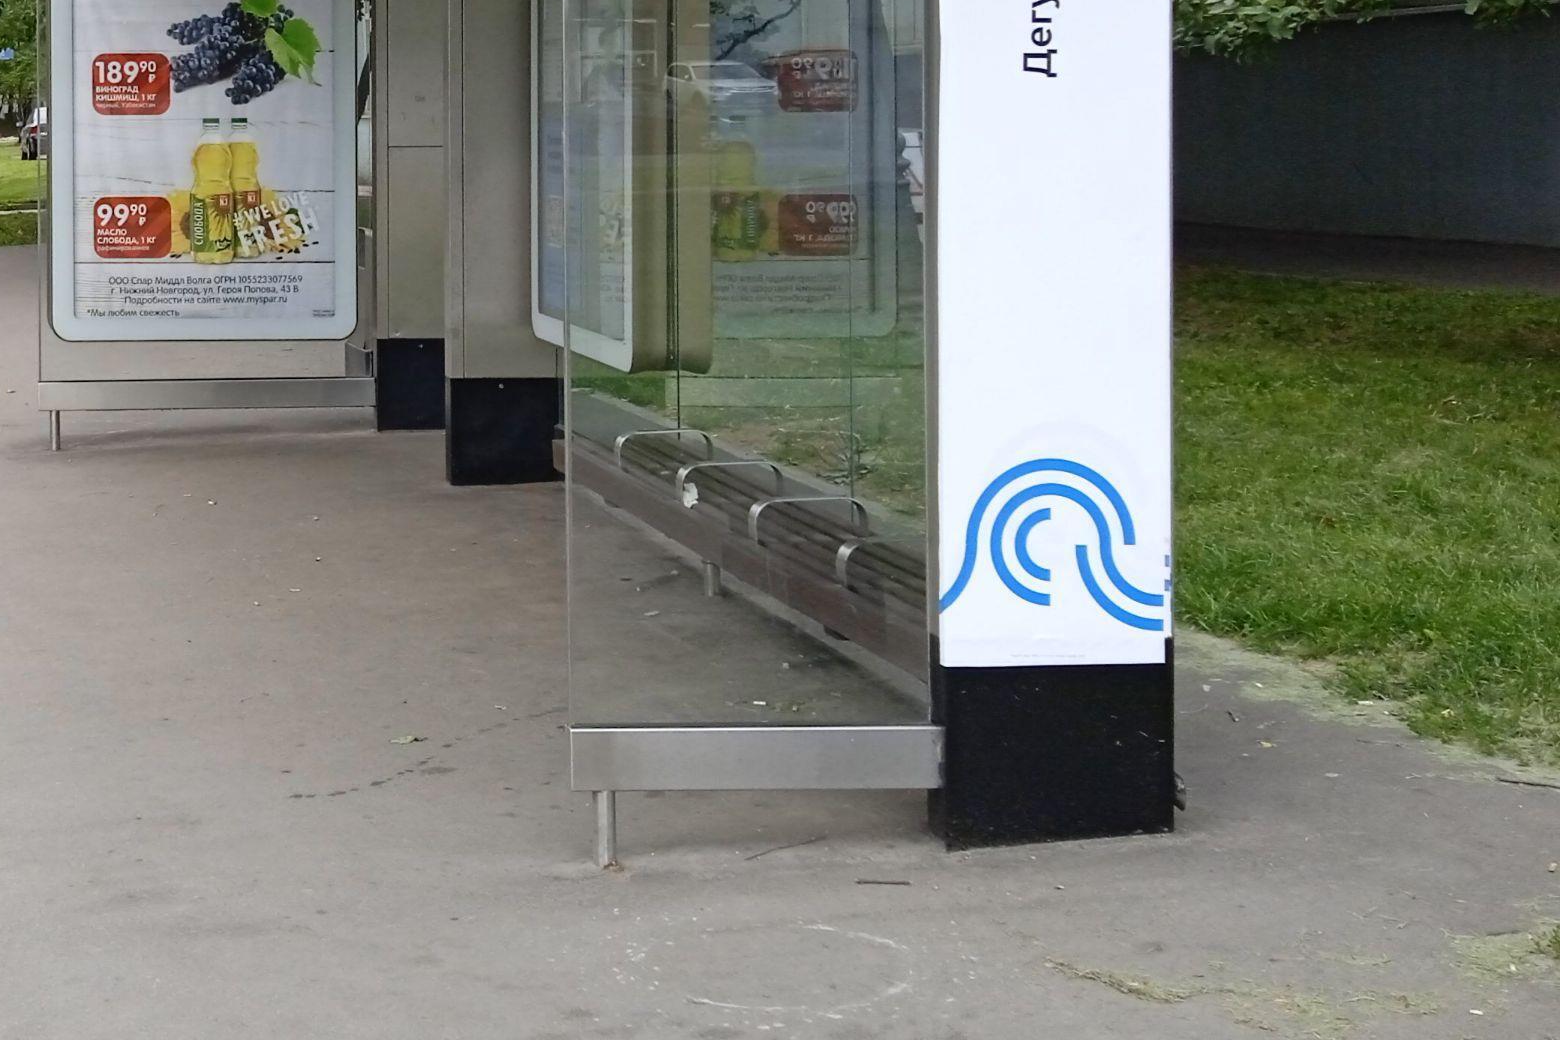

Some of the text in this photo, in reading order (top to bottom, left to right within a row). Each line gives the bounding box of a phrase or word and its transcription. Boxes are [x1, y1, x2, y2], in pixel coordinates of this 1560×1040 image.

[95, 85, 139, 93] ВИНОГРАД
[147, 93, 157, 101] КГ
[271, 190, 310, 216] LOVE
[97, 228, 128, 236] МАСЛО
[237, 206, 320, 258] FRESH
[97, 236, 139, 245] СЛОБОДА,
[146, 236, 156, 244] КГ
[108, 276, 129, 285] ООО
[131, 276, 153, 287] Спар
[186, 276, 212, 285] Волга
[214, 275, 236, 285] ОГРН
[119, 286, 155, 295] Нижний
[217, 285, 242, 295] Героя
[244, 285, 278, 294] Попова,
[281, 285, 291, 293] 43
[124, 296, 182, 305] Подробности
[196, 295, 221, 304] сайте
[222, 295, 288, 305] www.myspar.ru
[108, 308, 137, 317] любим
[139, 308, 180, 317] свежесть
